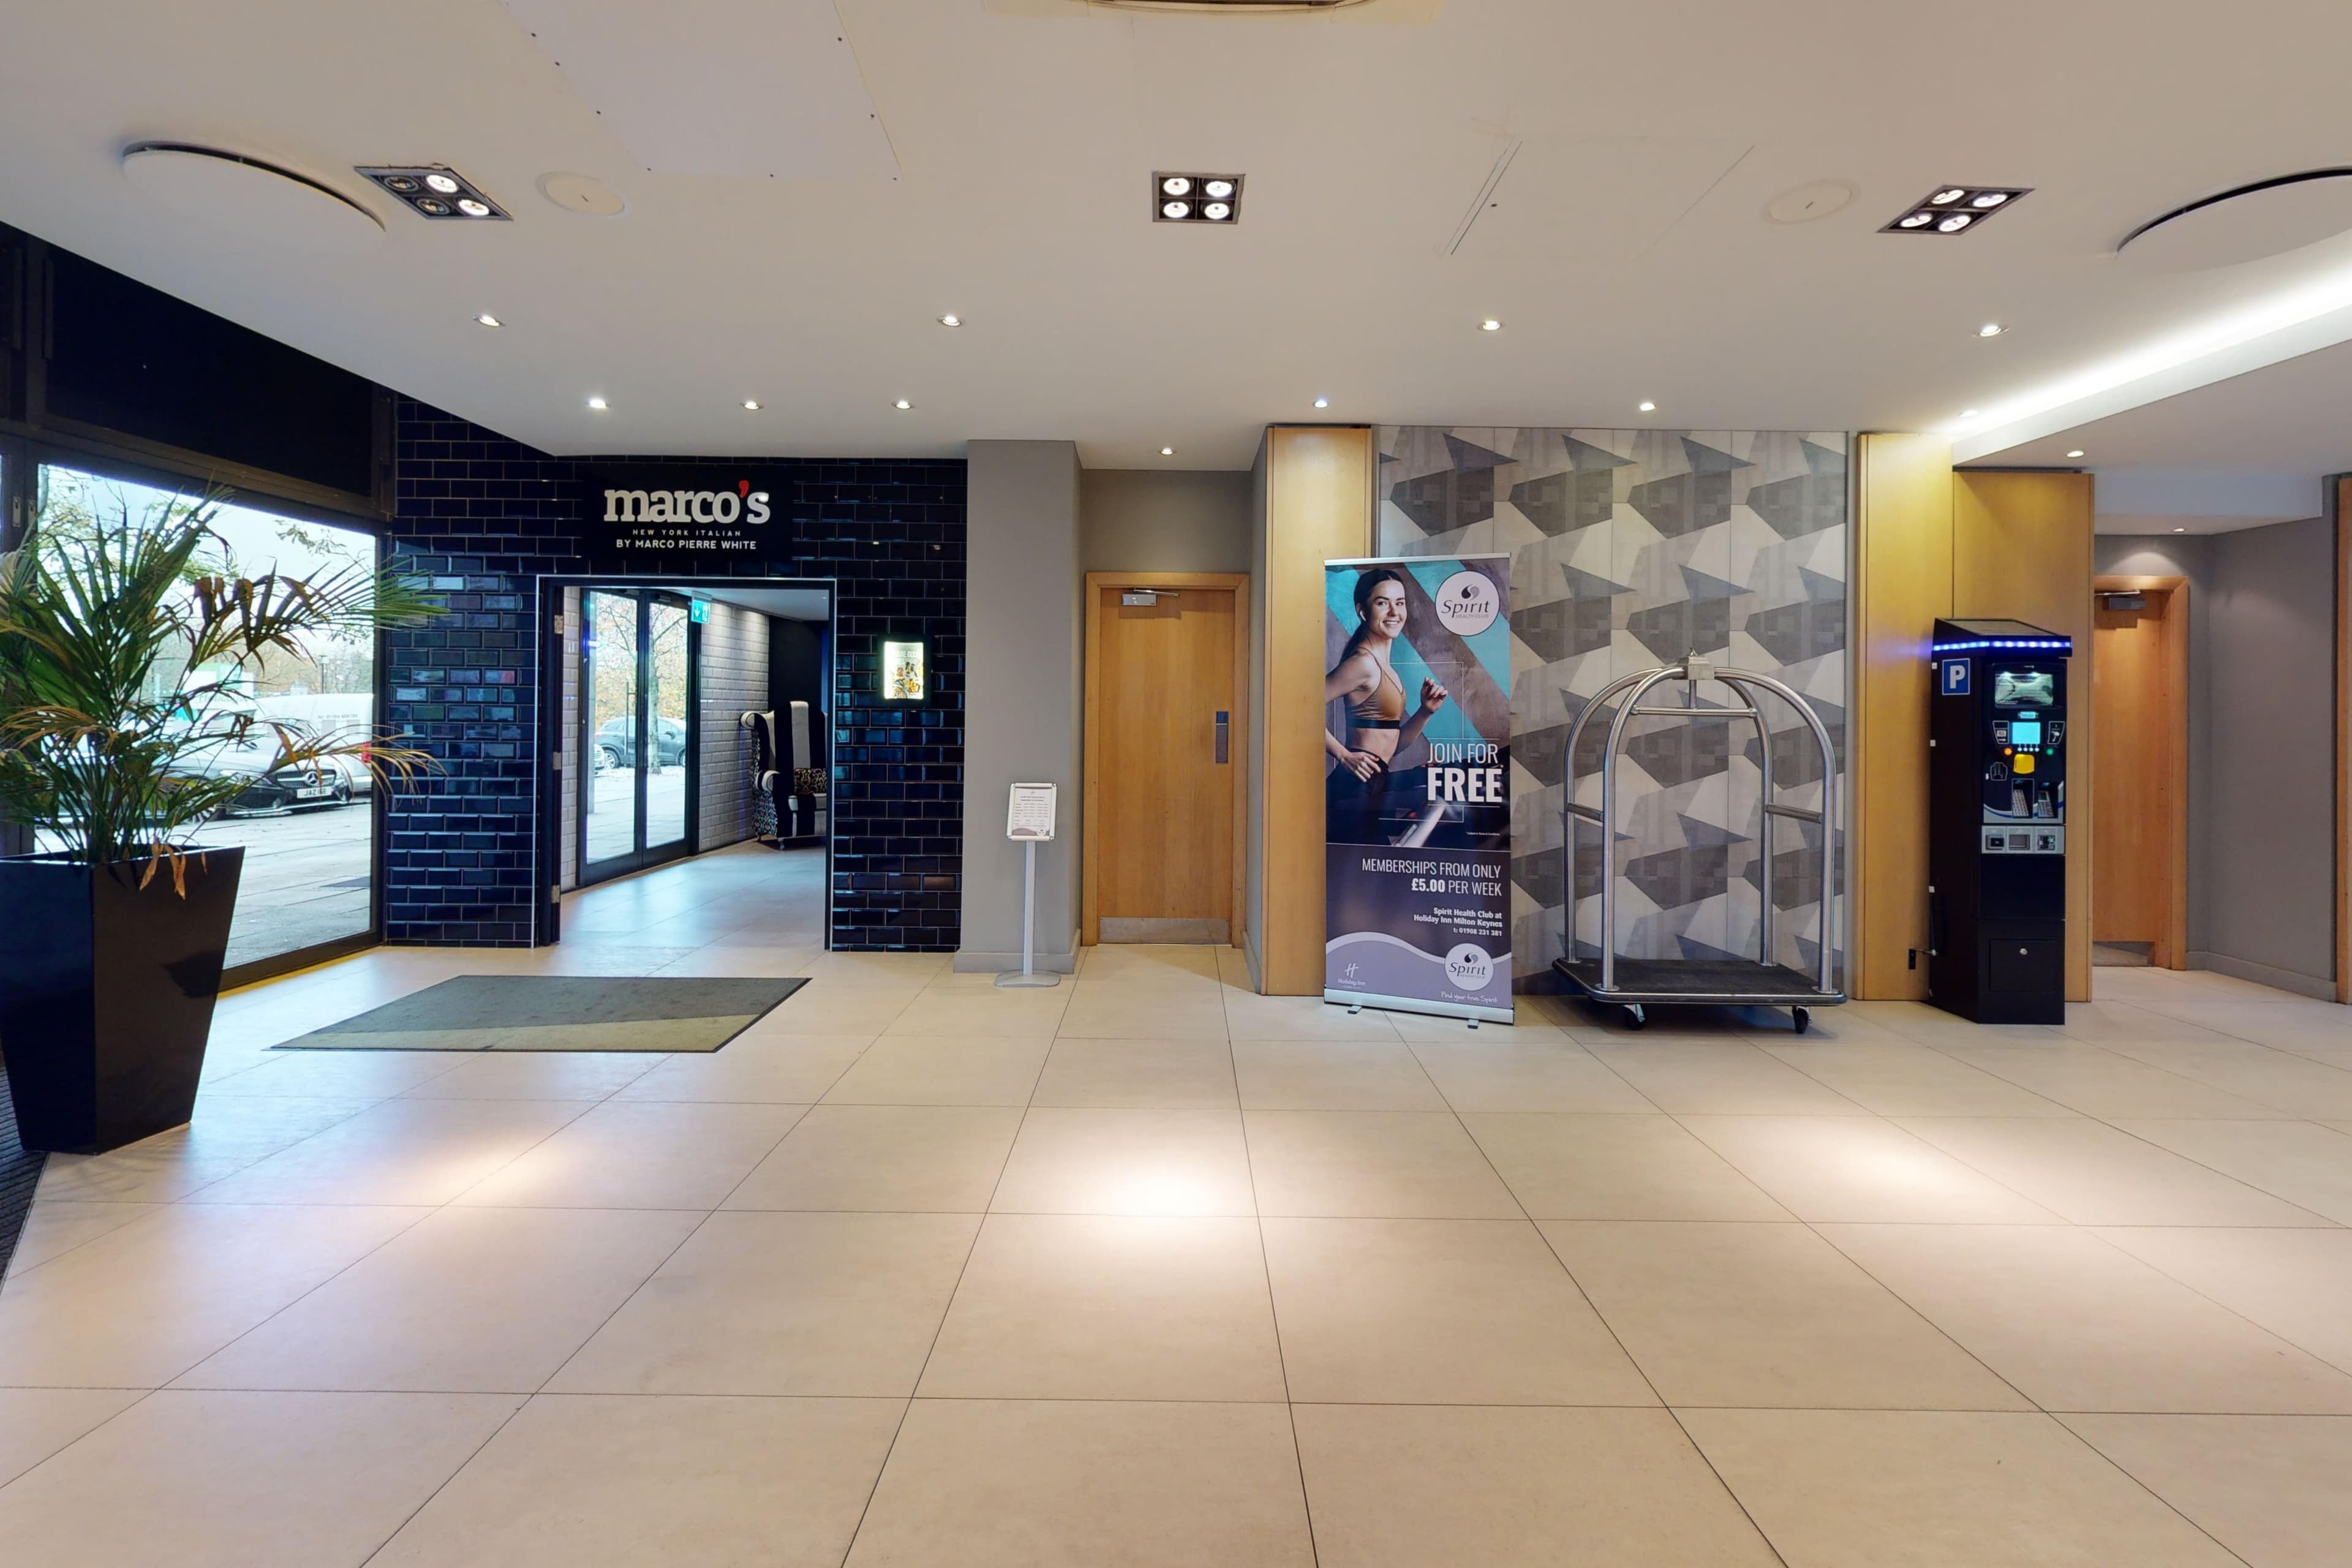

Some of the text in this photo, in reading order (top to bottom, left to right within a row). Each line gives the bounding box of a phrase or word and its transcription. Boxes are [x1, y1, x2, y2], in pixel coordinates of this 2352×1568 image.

[604, 480, 771, 524] marco's
[635, 540, 674, 548] MARCO
[679, 540, 716, 549] PIERRE
[722, 541, 756, 549] WHITE
[1441, 600, 1490, 618] Spirit
[1950, 665, 1966, 689] P
[1427, 743, 1498, 764] JOIN FOR
[1428, 767, 1502, 802] FREE
[1362, 858, 1501, 878] MEMBERSHIPS FROM ONLY
[1411, 878, 1502, 896] £5.00 PER WEEK
[1414, 914, 1439, 924] Holiday
[1477, 919, 1502, 928] Keynes
[1433, 907, 1452, 916] Spirit
[1453, 909, 1476, 918] Health
[1449, 962, 1486, 976] Spirit
